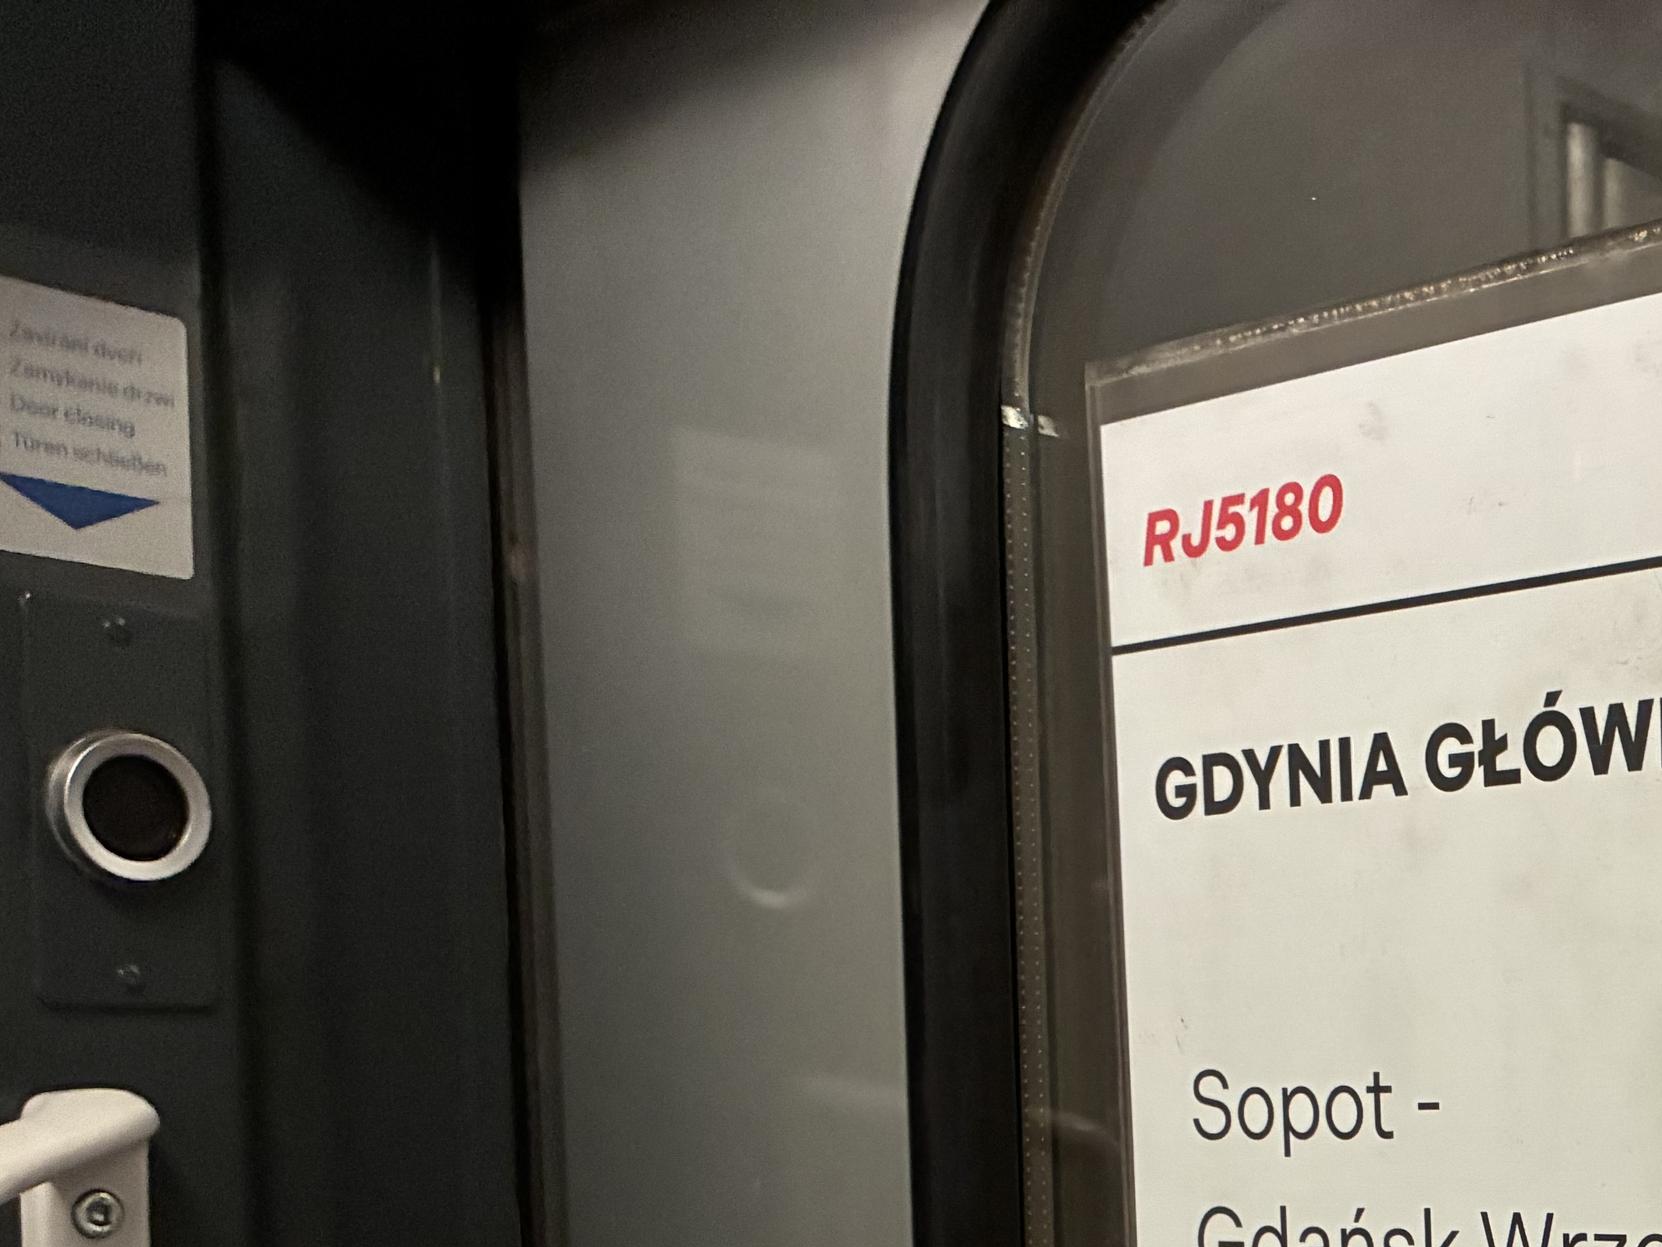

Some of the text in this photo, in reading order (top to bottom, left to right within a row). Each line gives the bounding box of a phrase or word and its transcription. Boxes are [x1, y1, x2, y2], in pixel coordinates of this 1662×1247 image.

[63, 405, 136, 439] closing
[1142, 473, 1344, 568] RJ5180
[1154, 730, 1409, 822] GDYNIA
[1191, 1067, 1395, 1159] Sopot
